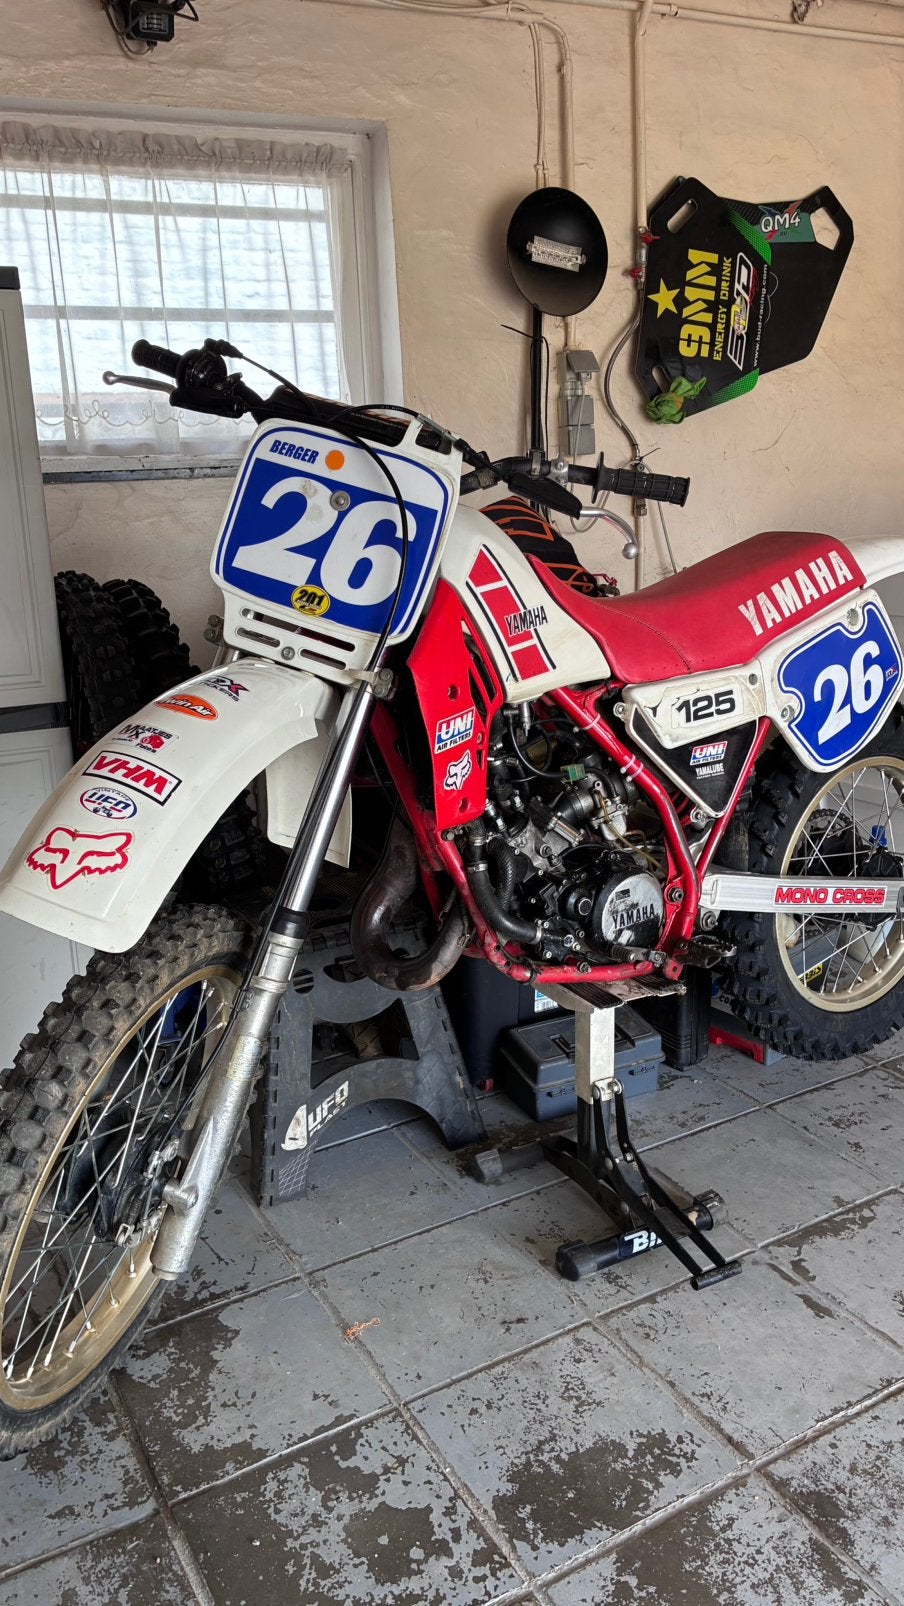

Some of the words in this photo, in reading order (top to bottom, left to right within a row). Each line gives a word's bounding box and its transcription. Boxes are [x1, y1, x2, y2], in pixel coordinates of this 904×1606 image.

[761, 211, 800, 232] QM4
[720, 256, 732, 301] DRINK
[678, 248, 719, 358] 9MM
[753, 264, 768, 367] www.bud-racing.com
[713, 305, 728, 361] ENERGY
[269, 439, 320, 465] BERGER
[231, 476, 417, 606] 26
[295, 588, 325, 607] 201
[738, 550, 853, 637] YAMAHA
[505, 606, 548, 636] YAMAHA
[676, 689, 736, 723] 125
[813, 640, 884, 746] 26
[190, 703, 215, 717] Air
[440, 711, 473, 741] UNI
[436, 740, 448, 752] AIR
[449, 731, 472, 746] FILTERS
[695, 743, 725, 759] UNI
[93, 755, 168, 796] VHM
[695, 762, 724, 776] YAMALUBE
[84, 791, 132, 813] UFO
[775, 887, 829, 904] MONO
[832, 888, 885, 904] CROSS
[612, 903, 655, 929] YAMAHA
[308, 1080, 349, 1132] UFO
